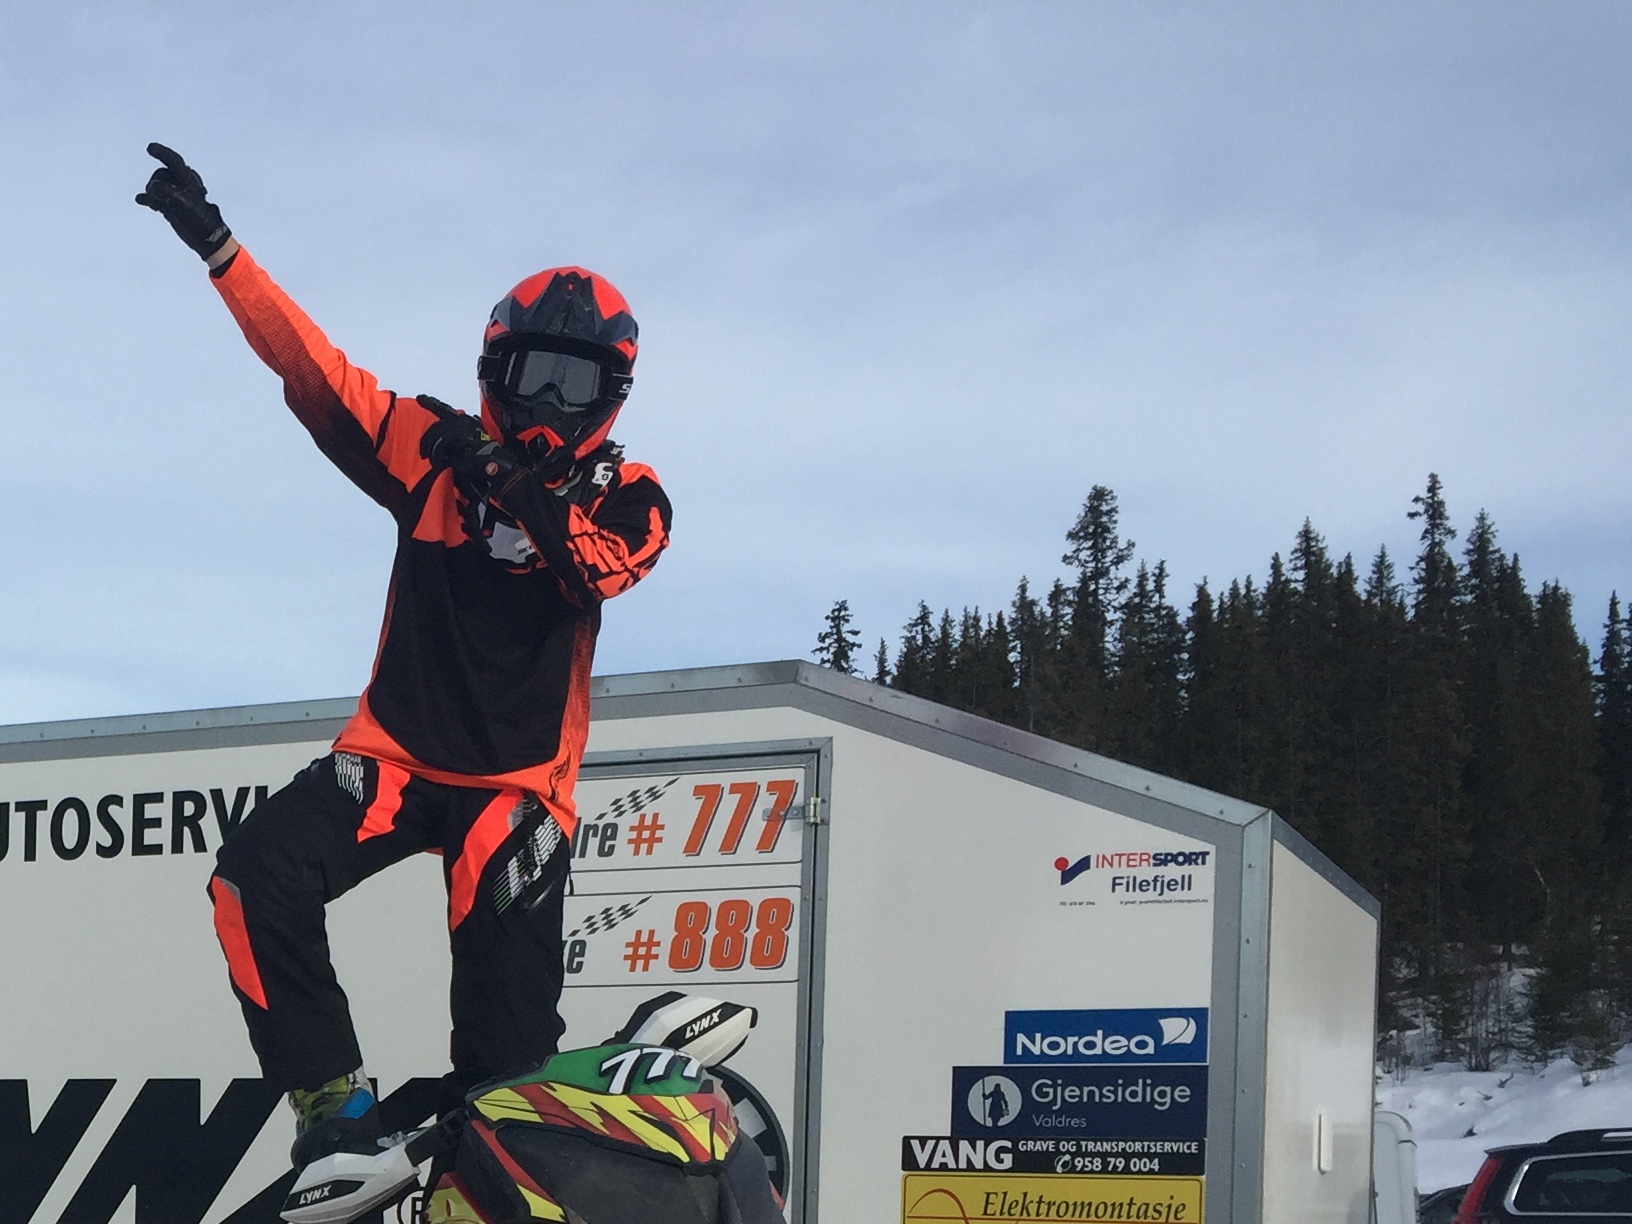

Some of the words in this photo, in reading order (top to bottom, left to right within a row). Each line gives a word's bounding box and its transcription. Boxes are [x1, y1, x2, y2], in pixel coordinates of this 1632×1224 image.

[682, 779, 800, 857] 777
[1095, 851, 1210, 869] INTERSPORT
[1111, 874, 1193, 896] Filefjell
[684, 1009, 723, 1040] LYNX
[1016, 1029, 1155, 1056] Nordea
[600, 1047, 702, 1095] 777
[1031, 1078, 1191, 1110] Gjensidige
[1032, 1114, 1087, 1128] Valdres
[910, 1139, 1013, 1170] VANG
[1018, 1140, 1056, 1152] GRAVE
[1059, 1141, 1076, 1152] OG
[1080, 1141, 1199, 1154] TRANSPORTSERVICE
[1074, 1158, 1102, 1171] 958
[1106, 1158, 1124, 1171] 79
[1129, 1158, 1160, 1172] 004
[299, 1184, 332, 1205] LYNX
